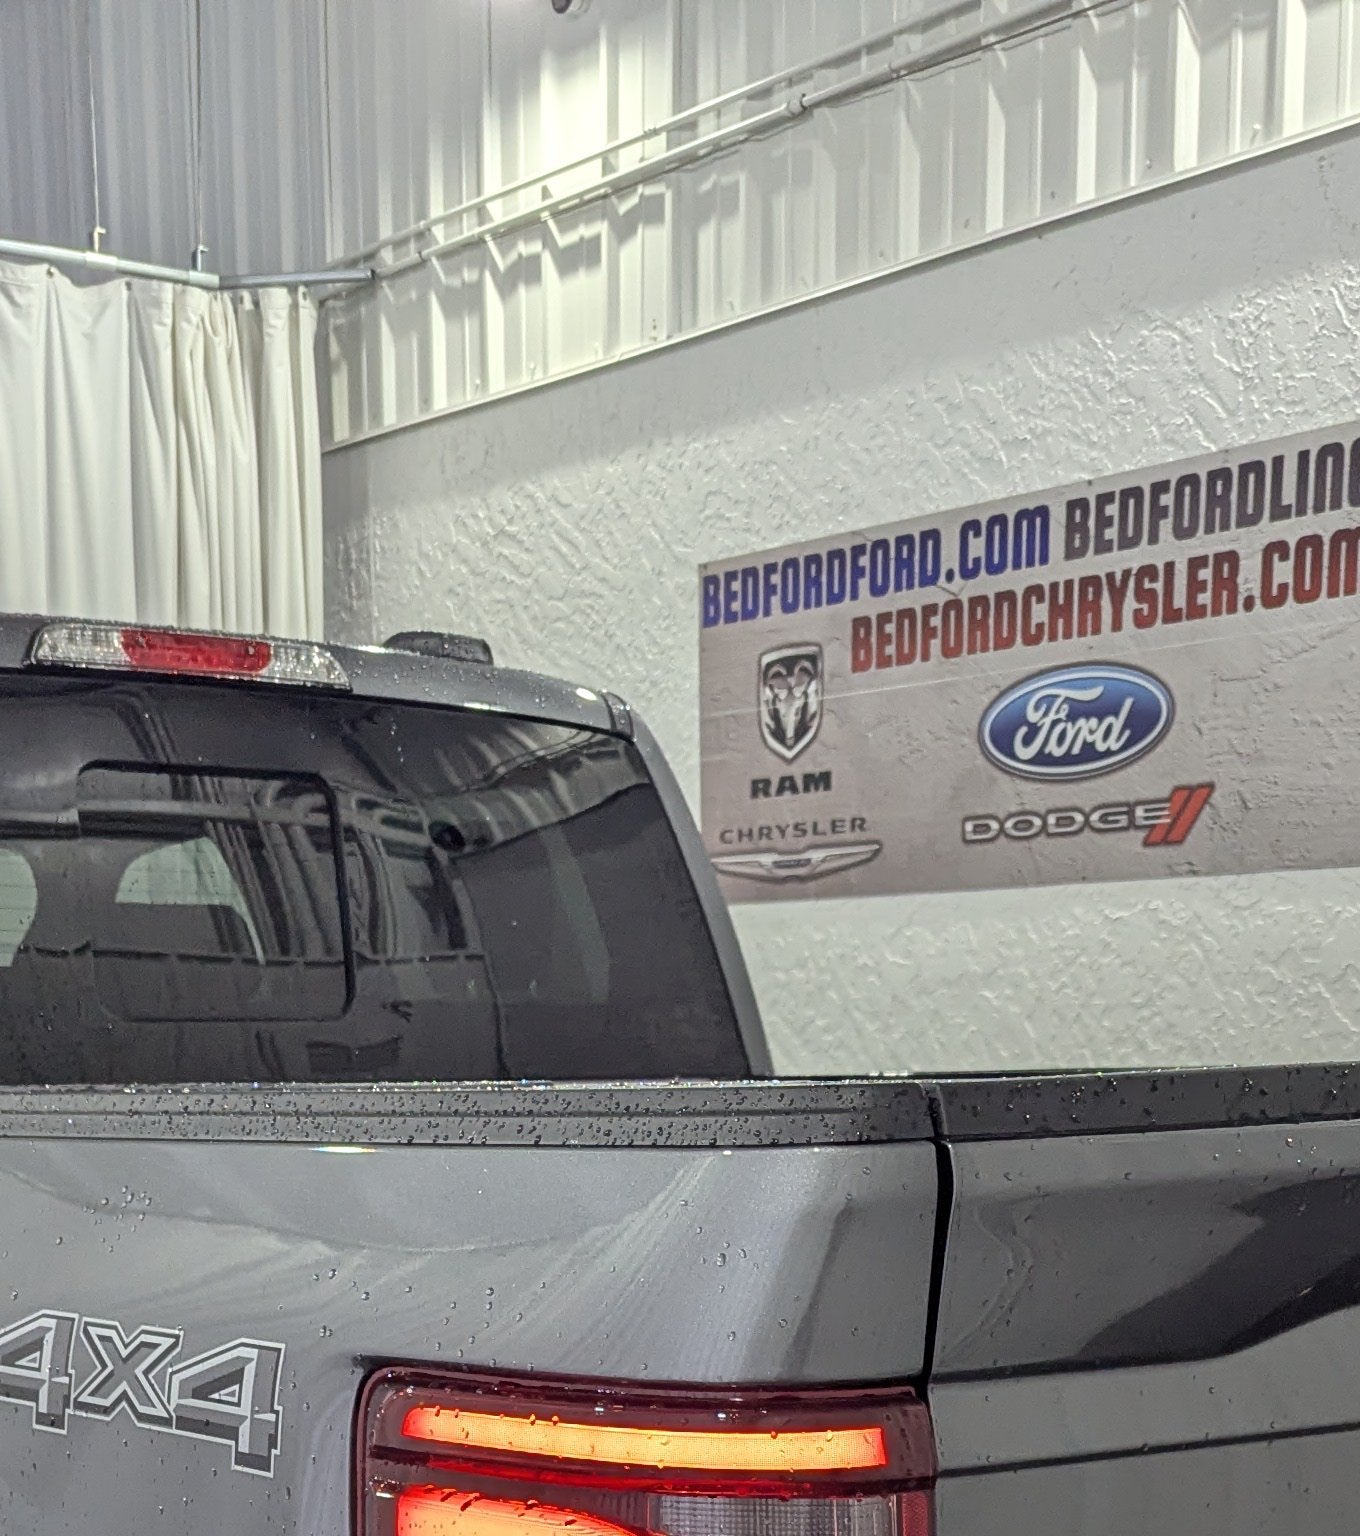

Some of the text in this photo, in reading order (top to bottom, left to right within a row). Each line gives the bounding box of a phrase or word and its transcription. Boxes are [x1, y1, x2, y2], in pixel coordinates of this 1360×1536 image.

[703, 503, 1051, 630] BEDFORDFORD.COM
[1013, 687, 1132, 759] Ford
[751, 769, 832, 799] RAM
[719, 816, 868, 845] CHRYSLER
[961, 800, 1174, 843] DODGE
